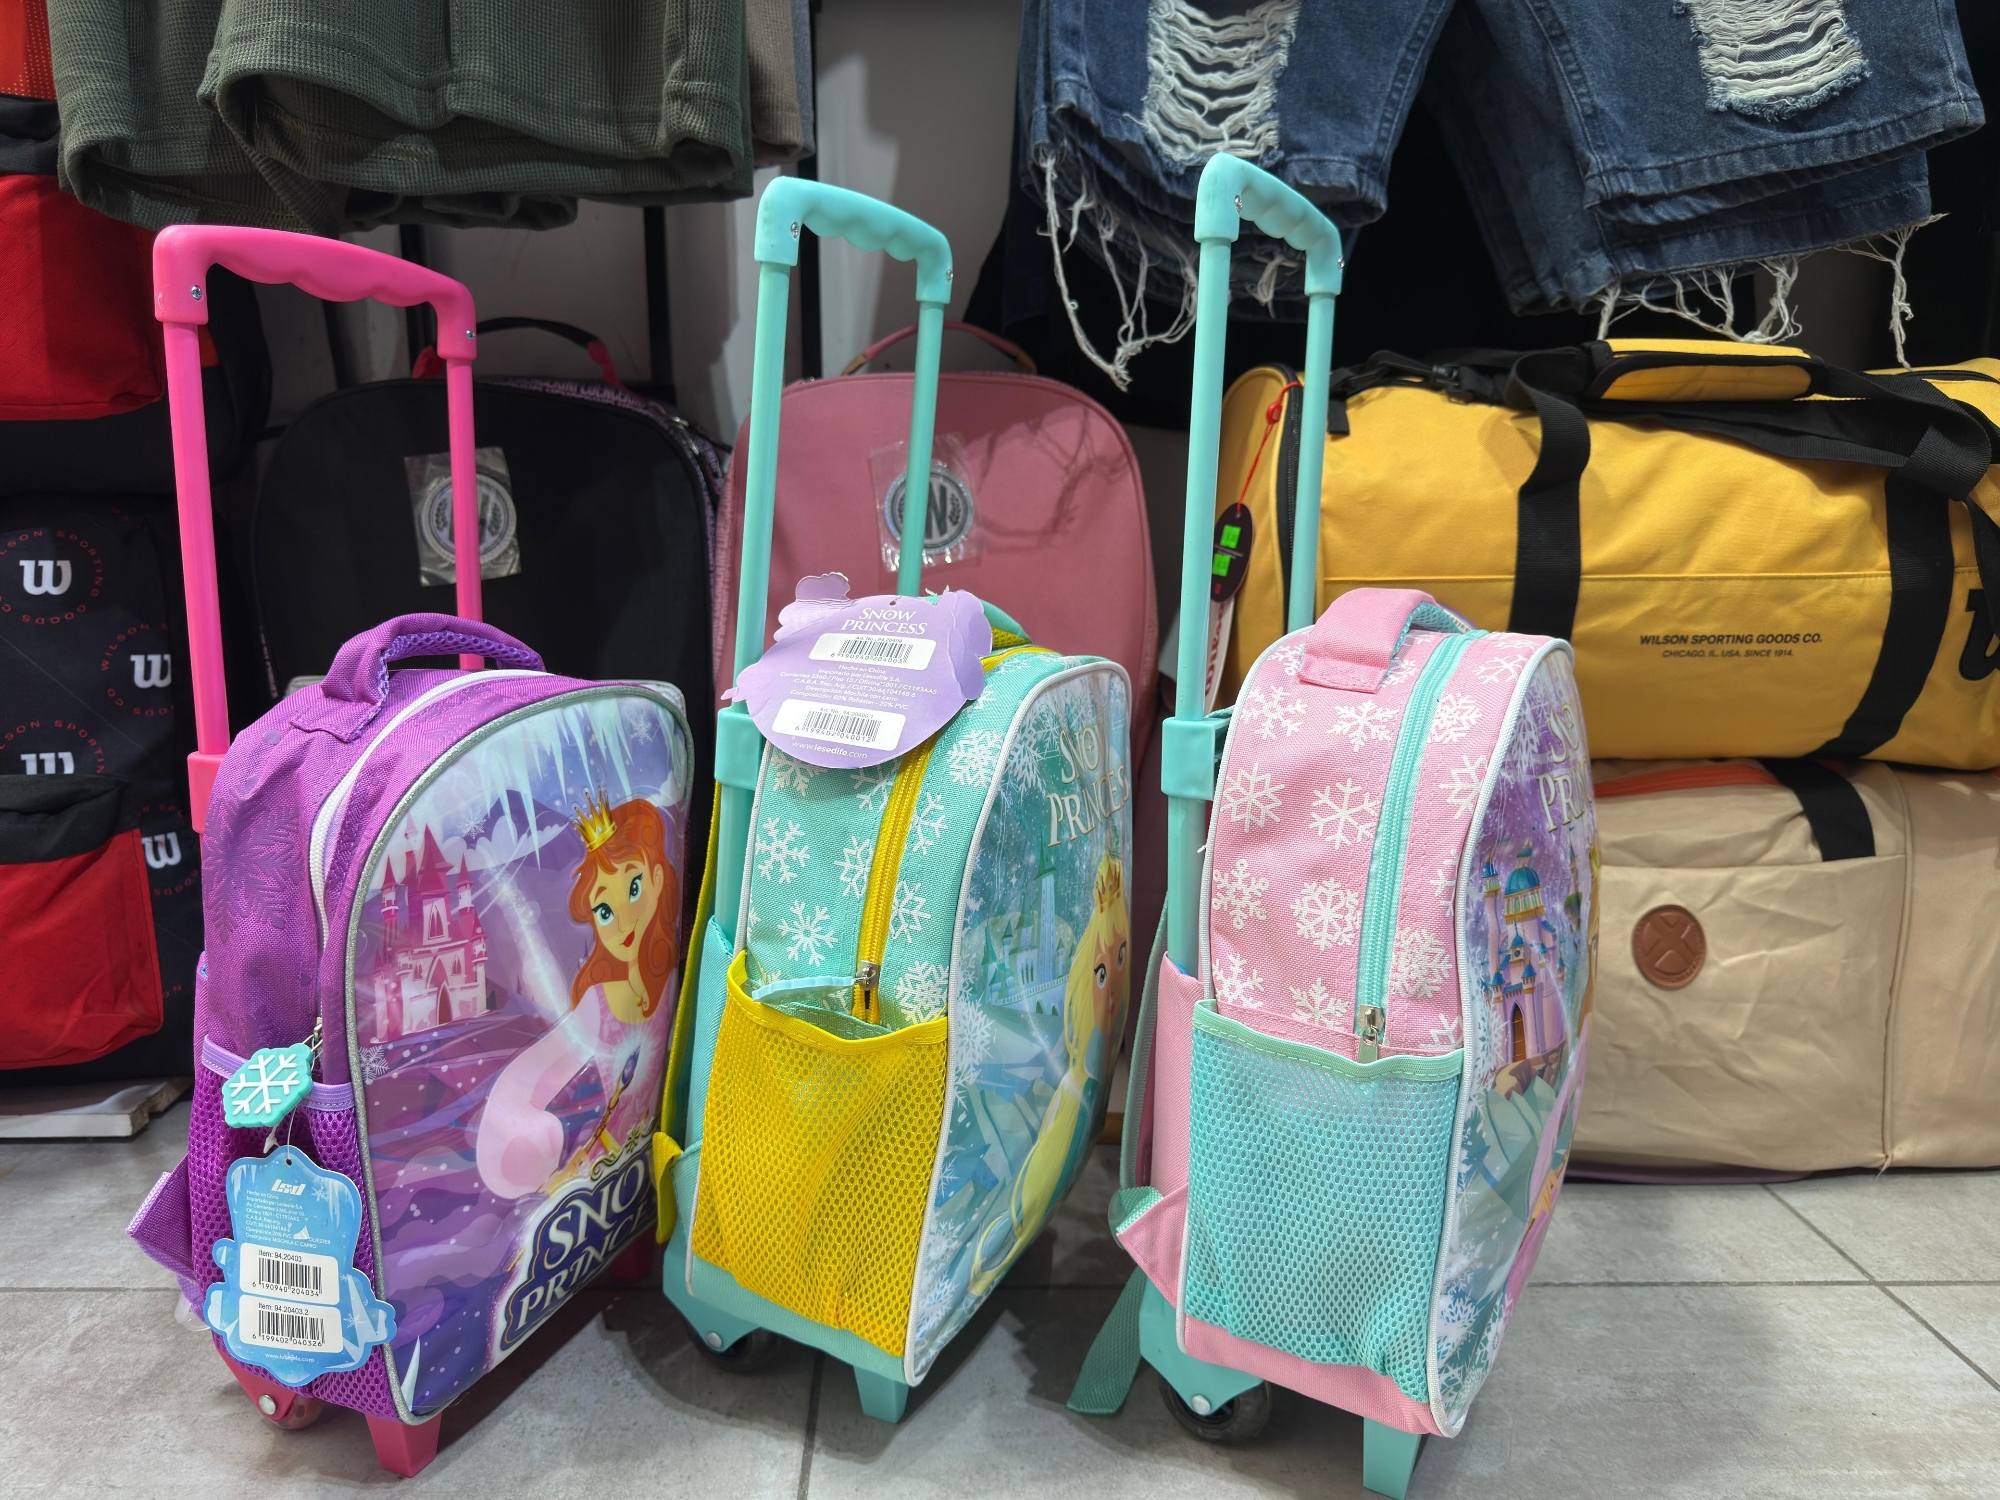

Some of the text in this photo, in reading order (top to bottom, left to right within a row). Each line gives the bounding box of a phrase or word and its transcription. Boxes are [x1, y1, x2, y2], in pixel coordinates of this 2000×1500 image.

[859, 607, 917, 621] SNOW
[840, 619, 928, 635] PRINCESS
[1640, 633, 1822, 645] WILSON SPORTING GOODS CO.
[1744, 649, 1772, 657] SINCE
[54, 719, 105, 774] SPORTIN
[1047, 765, 1130, 848] PRINCES
[544, 1155, 649, 1270] SNO
[258, 1249, 302, 1262] Item: 94.20403
[261, 1283, 288, 1293] 190940
[291, 1287, 319, 1297] 204034
[258, 1302, 309, 1316] Item: 94.20403.2
[261, 1335, 289, 1344] 199402
[292, 1339, 322, 1347] 040326
